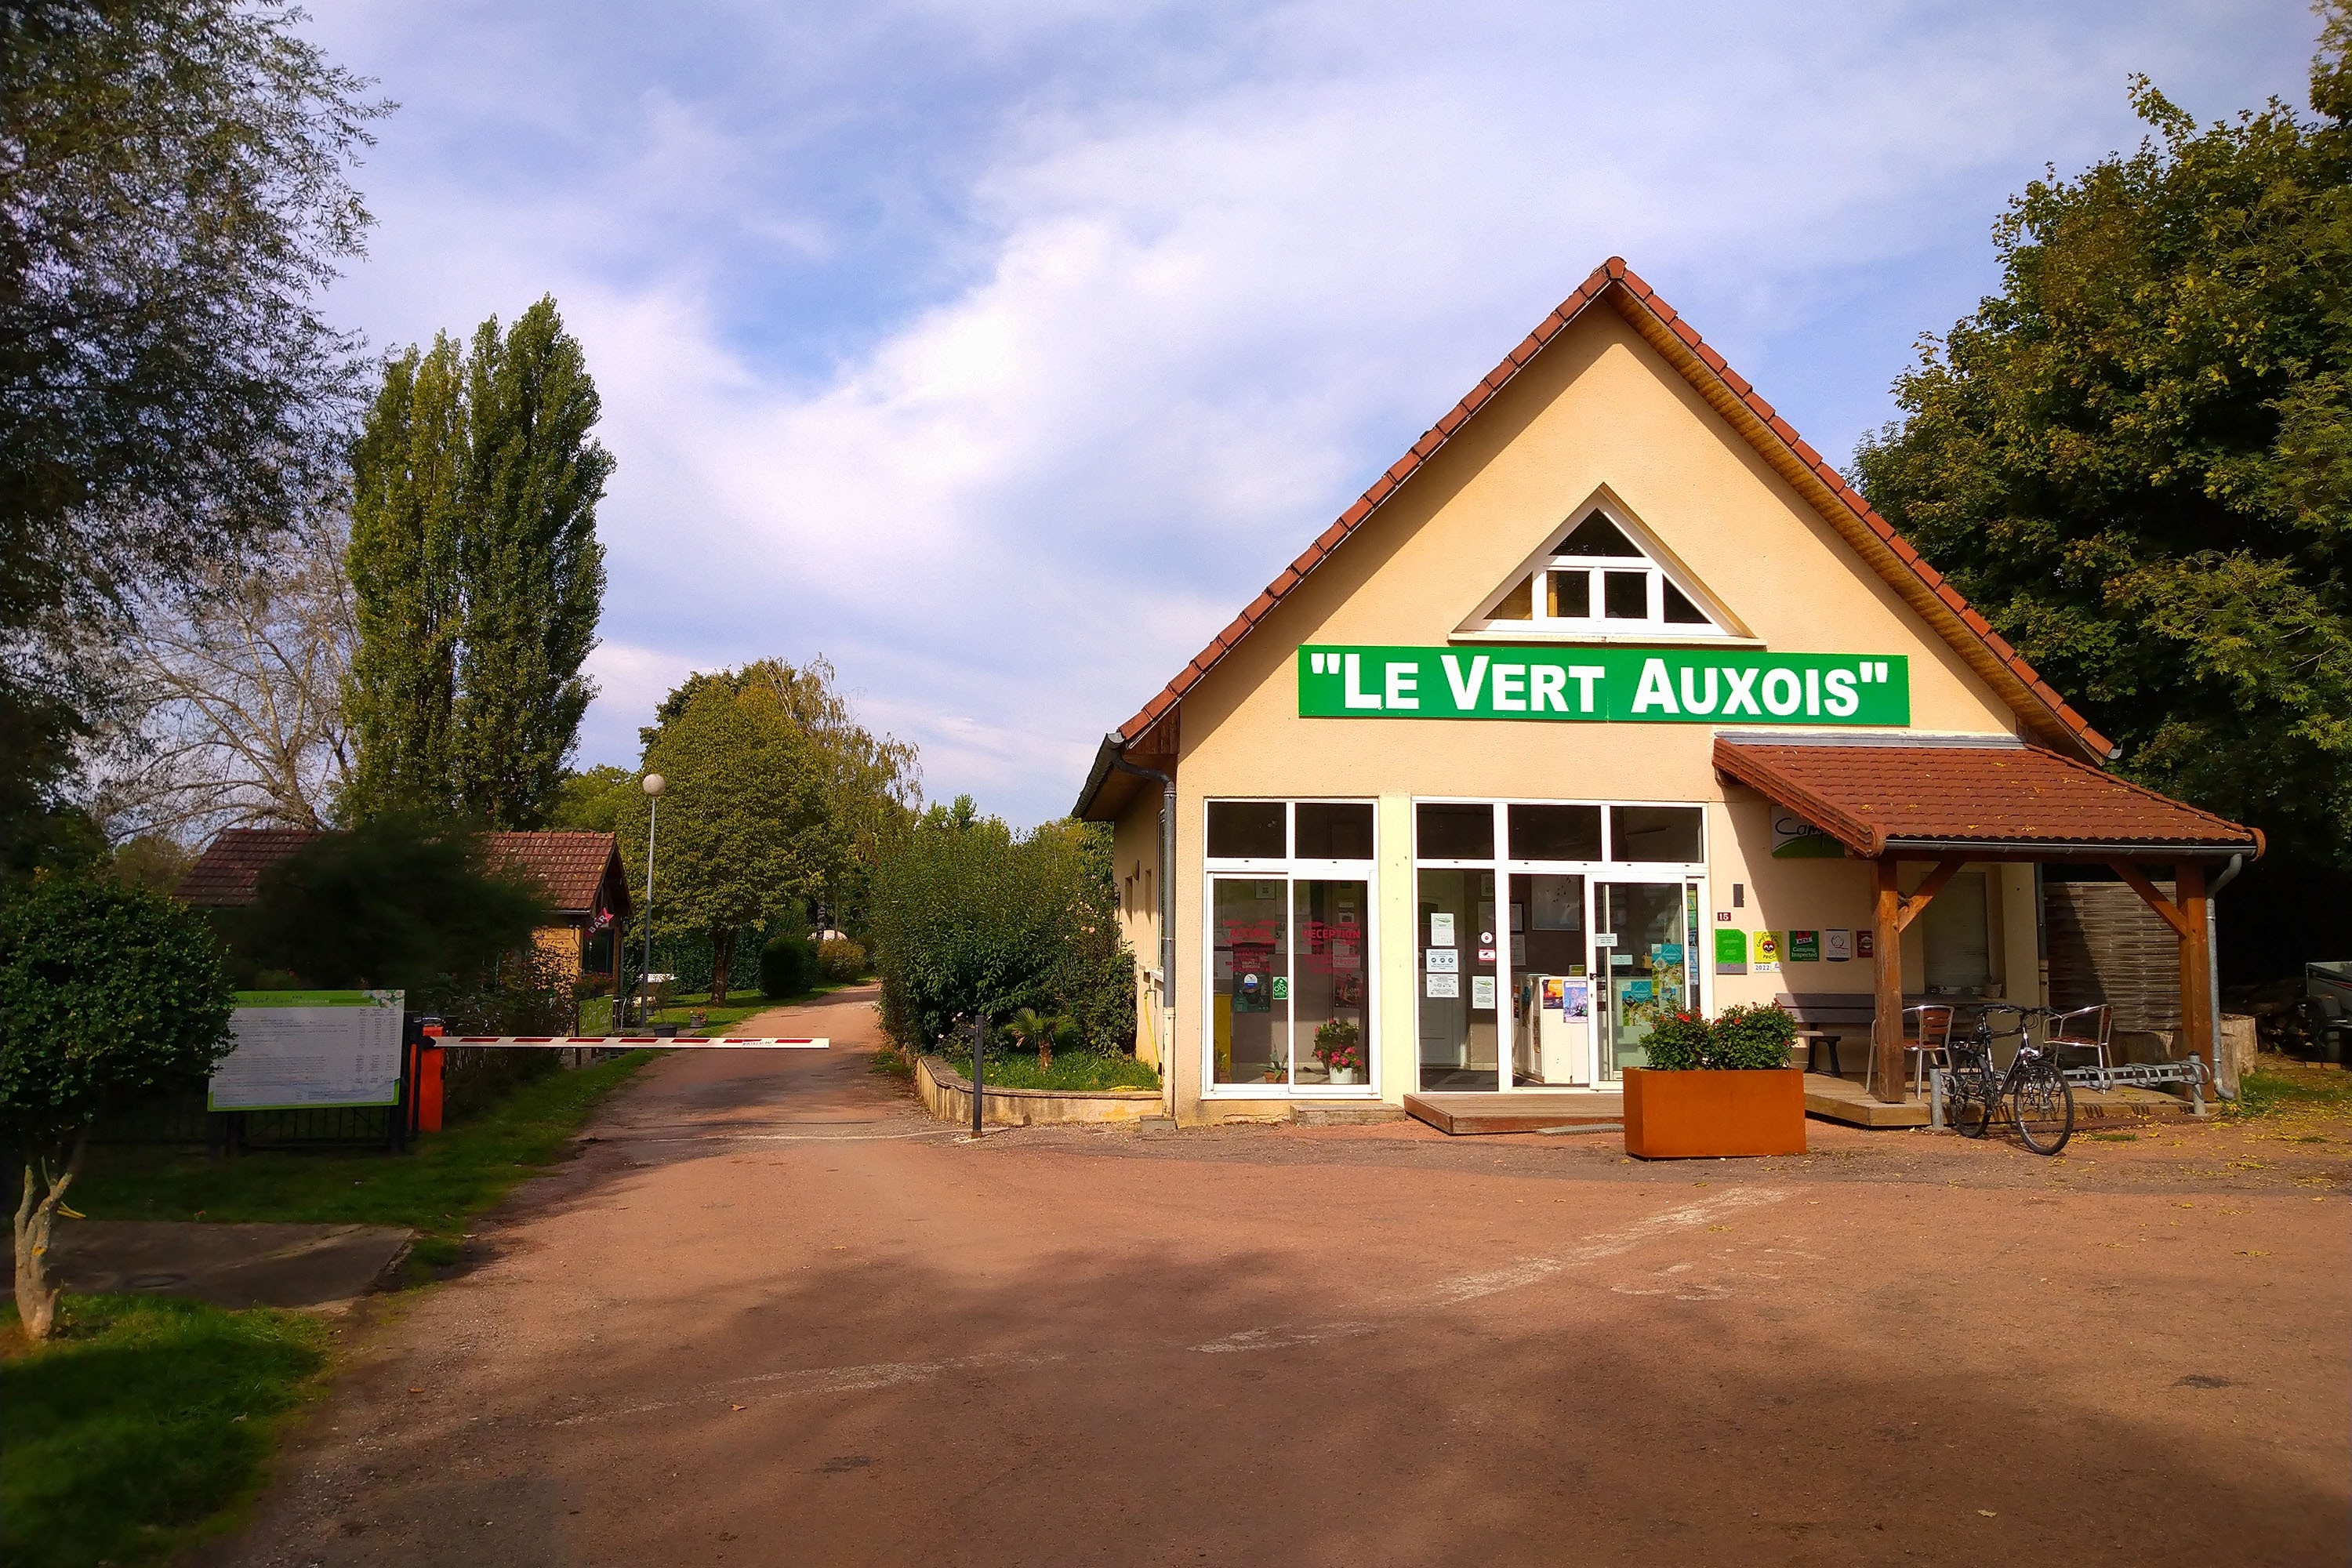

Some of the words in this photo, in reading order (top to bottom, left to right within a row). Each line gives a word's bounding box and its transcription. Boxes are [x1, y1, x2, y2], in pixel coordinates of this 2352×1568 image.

[1310, 652, 1420, 710] "LE
[1439, 654, 1606, 713] VERT
[1630, 657, 1889, 717] AUXOIS"
[588, 915, 607, 933] BAR
[1719, 913, 1730, 921] 15
